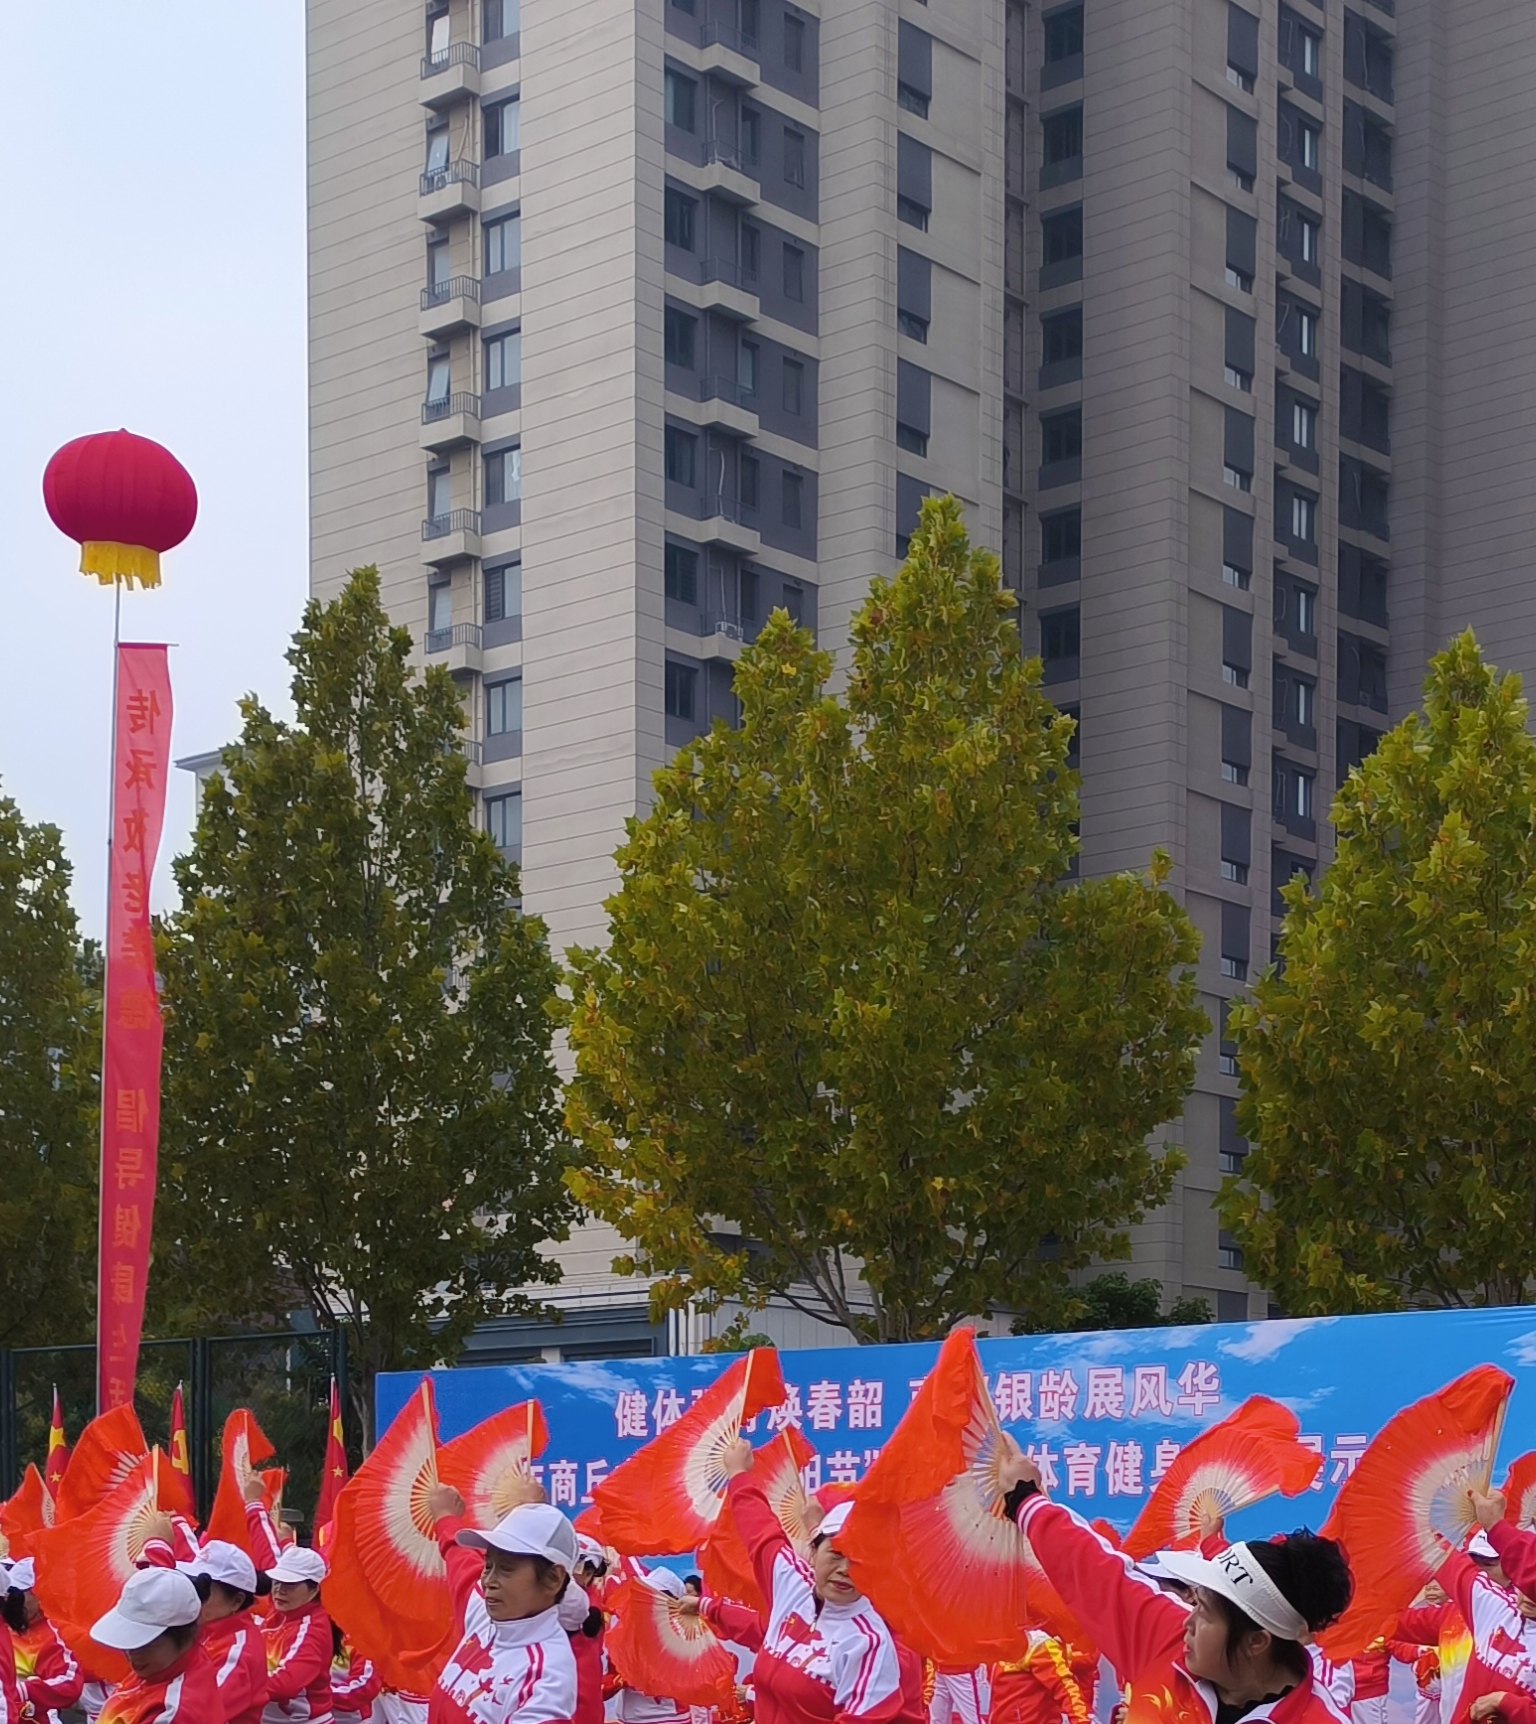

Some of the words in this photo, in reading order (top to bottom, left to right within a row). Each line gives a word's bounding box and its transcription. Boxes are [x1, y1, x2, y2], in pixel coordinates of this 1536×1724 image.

[614, 1378, 884, 1438] 健体焕春韶
[909, 1360, 1221, 1422] 银龄展风华
